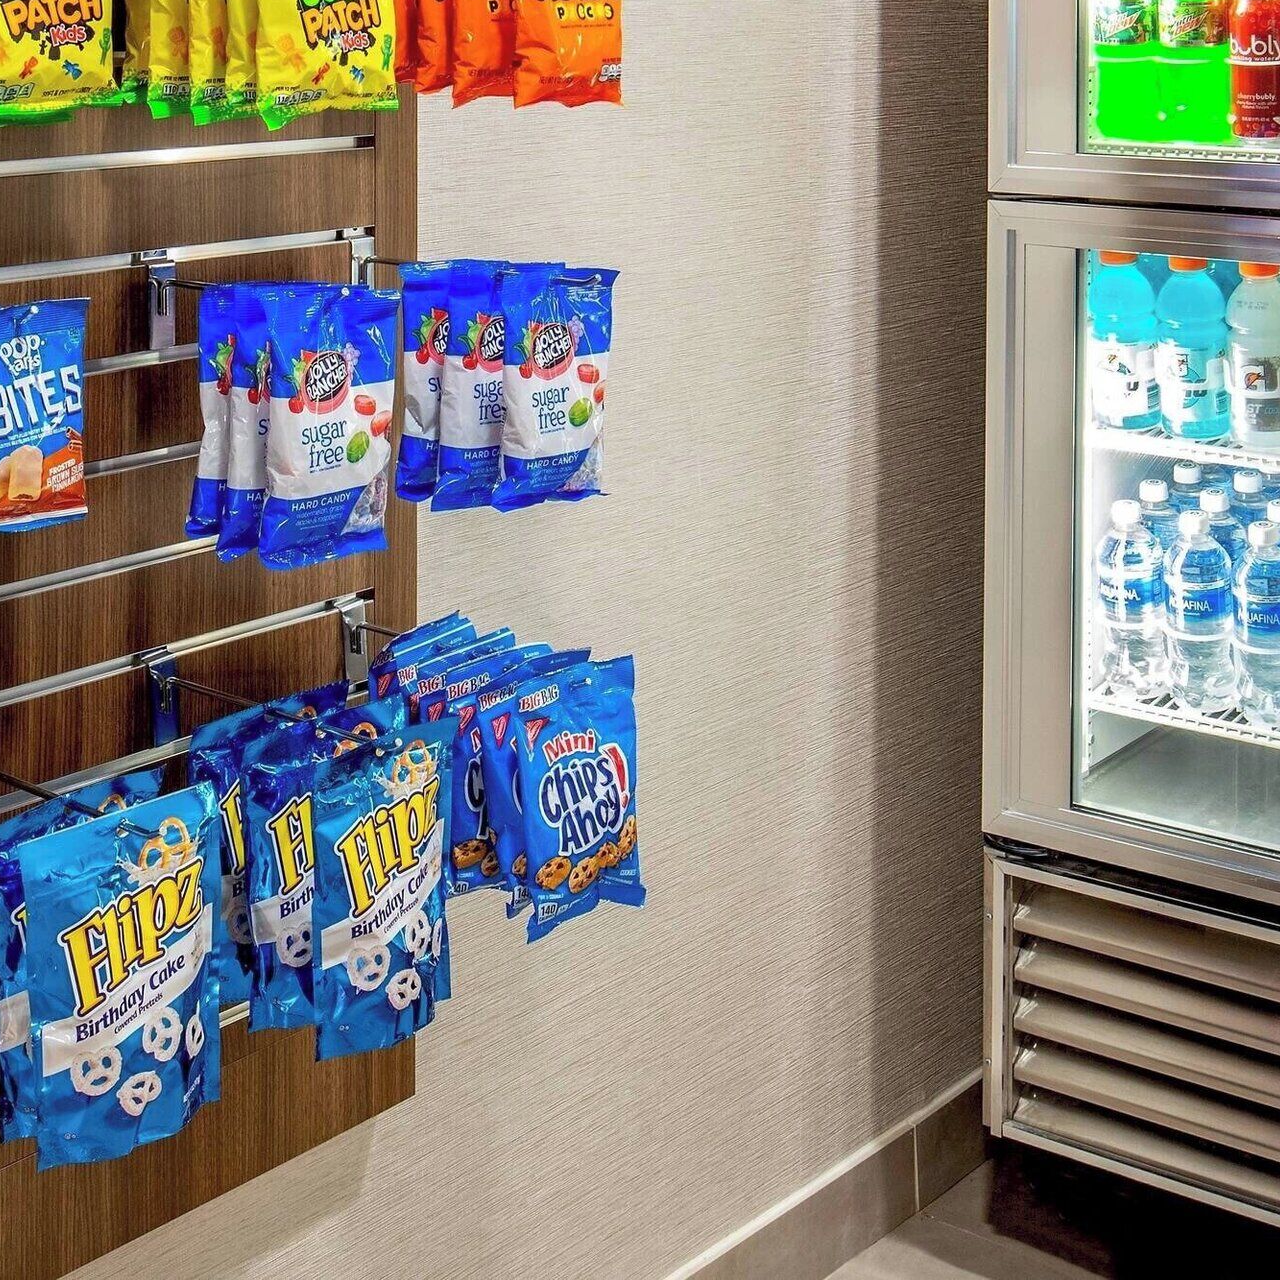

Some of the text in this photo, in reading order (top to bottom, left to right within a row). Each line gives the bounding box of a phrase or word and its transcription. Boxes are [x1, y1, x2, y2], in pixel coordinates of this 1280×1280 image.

[50, 24, 87, 47] Kids
[307, 364, 348, 401] RANCHER
[309, 354, 341, 383] JOLLY
[302, 419, 347, 447] sugar
[310, 445, 344, 468] free
[292, 492, 351, 512] HARD CANDY
[520, 685, 558, 712] BIG BAG
[543, 730, 597, 764] Mini
[541, 757, 614, 822] Chips
[336, 777, 439, 919] Flipz
[351, 891, 405, 939] Birthday
[60, 859, 202, 1017] Flipz
[76, 955, 185, 1043] Birthday Cake
[115, 992, 163, 1034] Covered Pretzels
